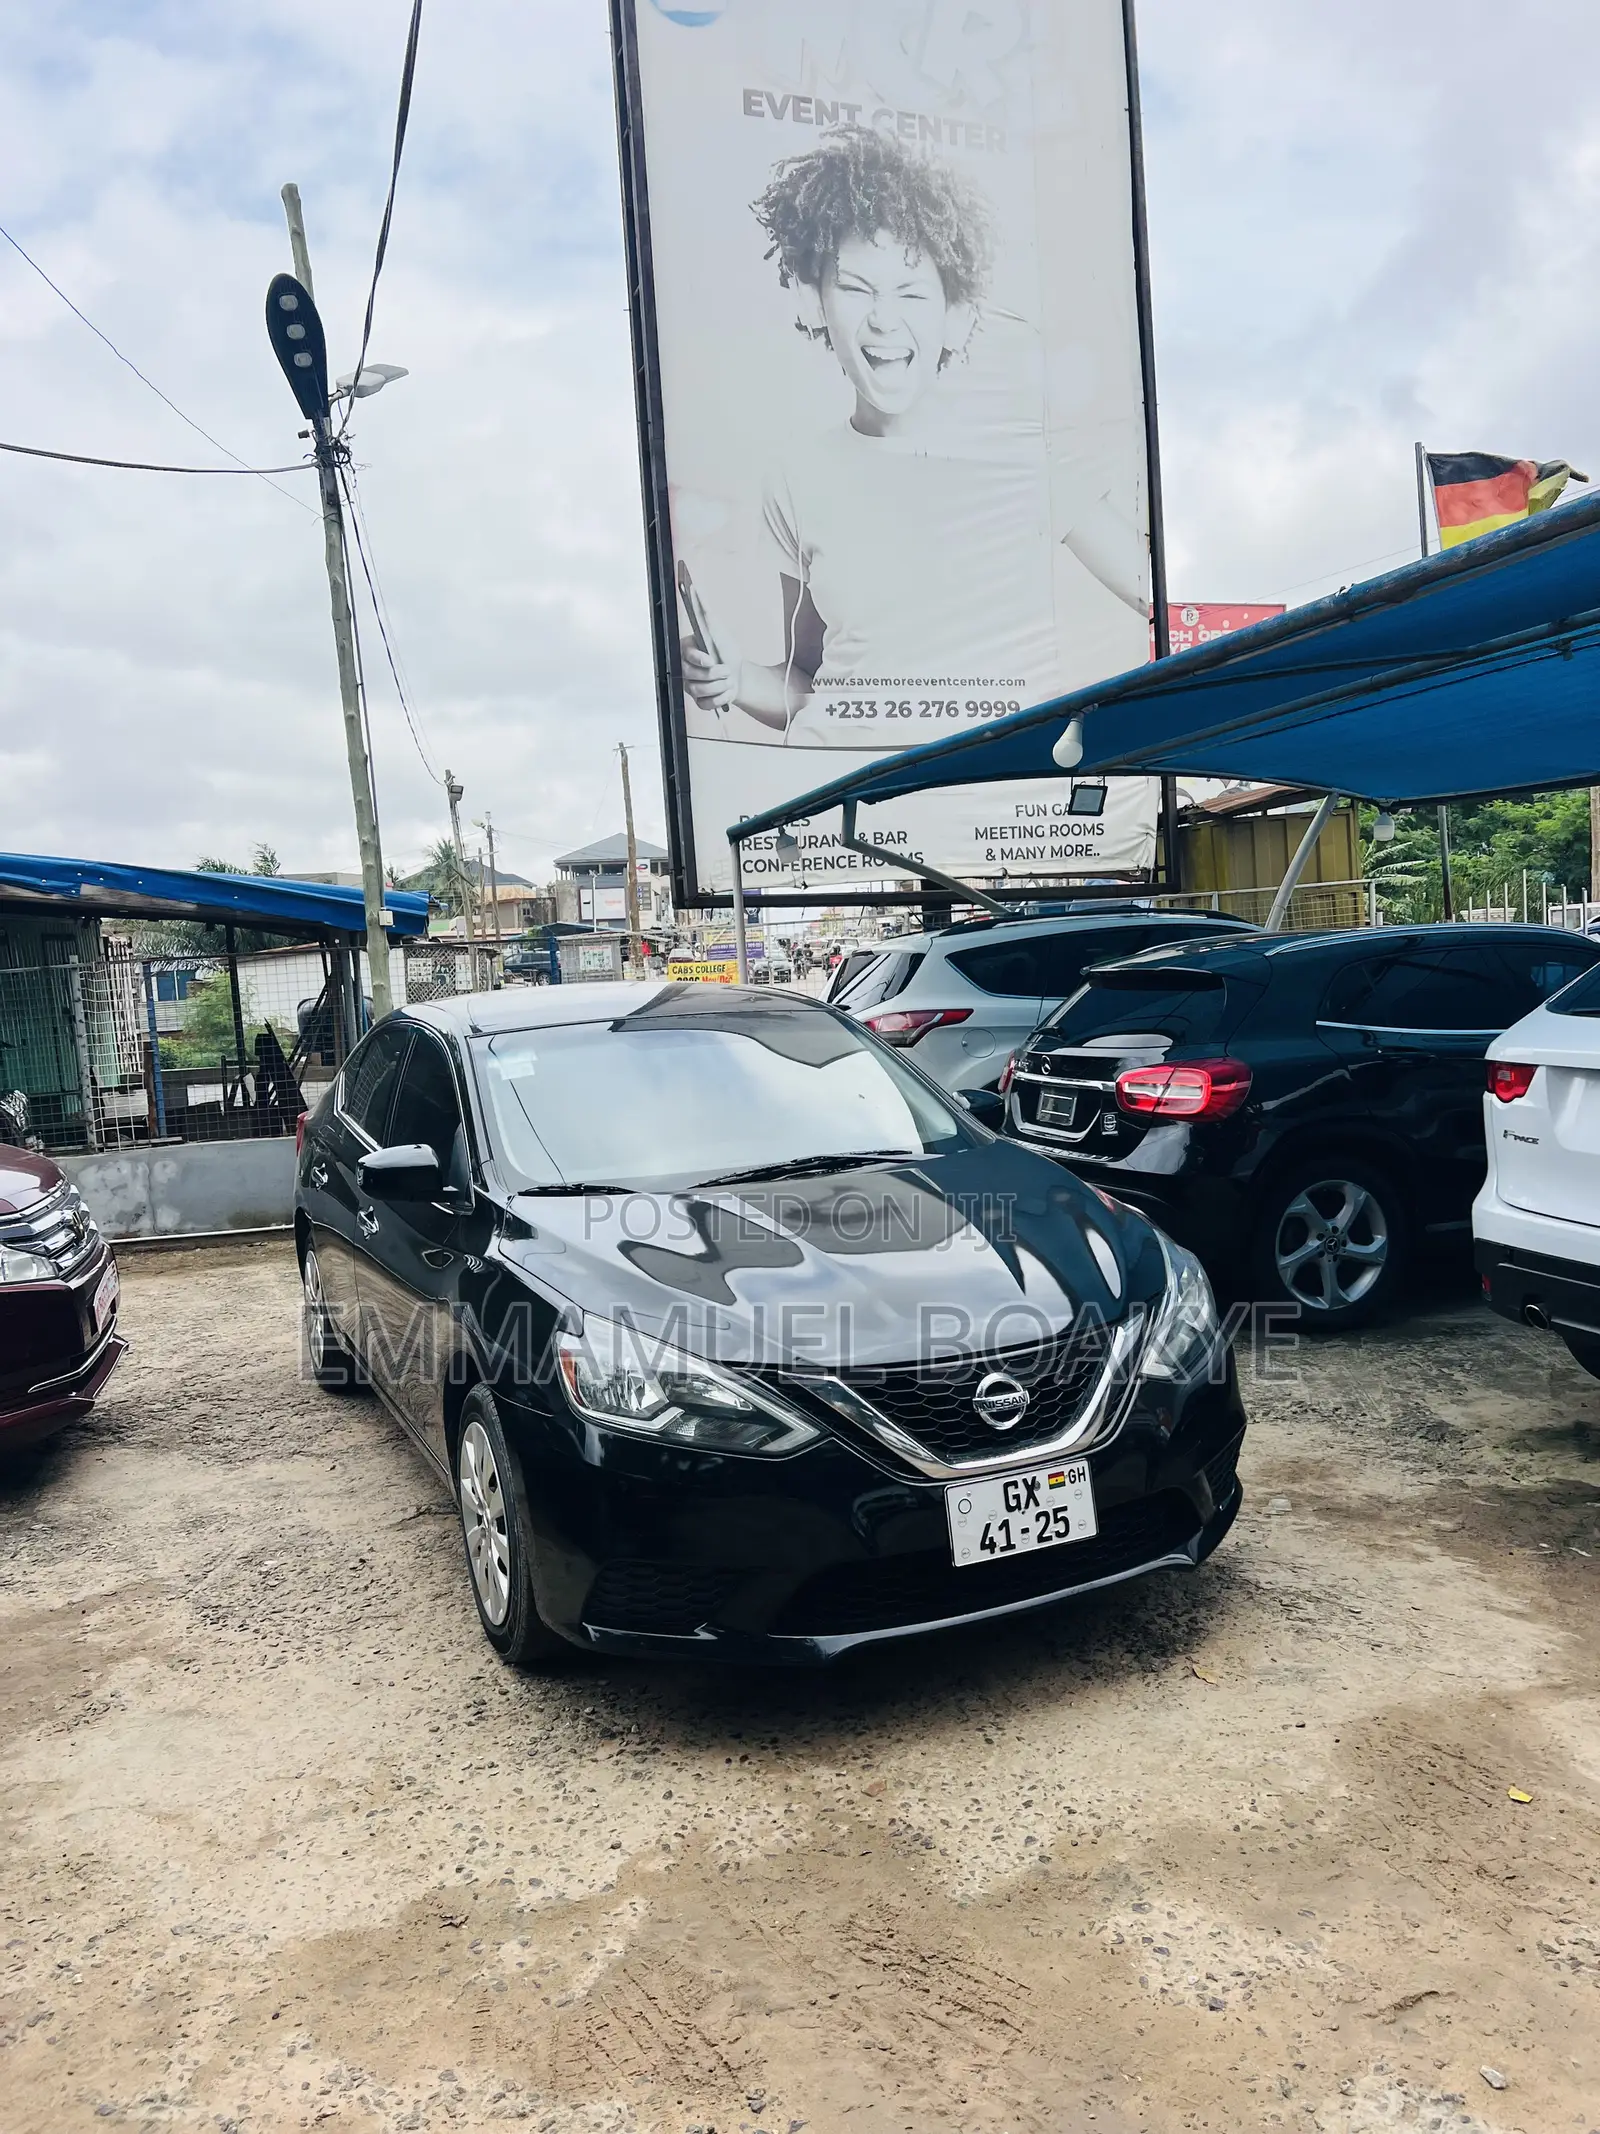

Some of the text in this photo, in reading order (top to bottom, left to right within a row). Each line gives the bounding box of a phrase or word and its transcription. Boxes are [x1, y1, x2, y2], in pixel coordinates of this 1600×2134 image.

[743, 88, 1007, 151] EVENT CENTER
[812, 676, 1025, 687] www.savemoreeventcenter.com
[825, 700, 1020, 719] +233 26 276 9999
[1015, 804, 1047, 817] FUN
[873, 831, 908, 845] BAR
[975, 823, 1105, 840] MEETING ROOMS
[985, 844, 1100, 861] & MANY MORE..
[742, 855, 857, 873] CONFERENCE
[672, 964, 726, 974] CABS COLLEGE
[981, 1395, 1026, 1410] NISSAN
[1003, 1466, 1086, 1513] GX GH
[980, 1506, 1070, 1554] 41-25
